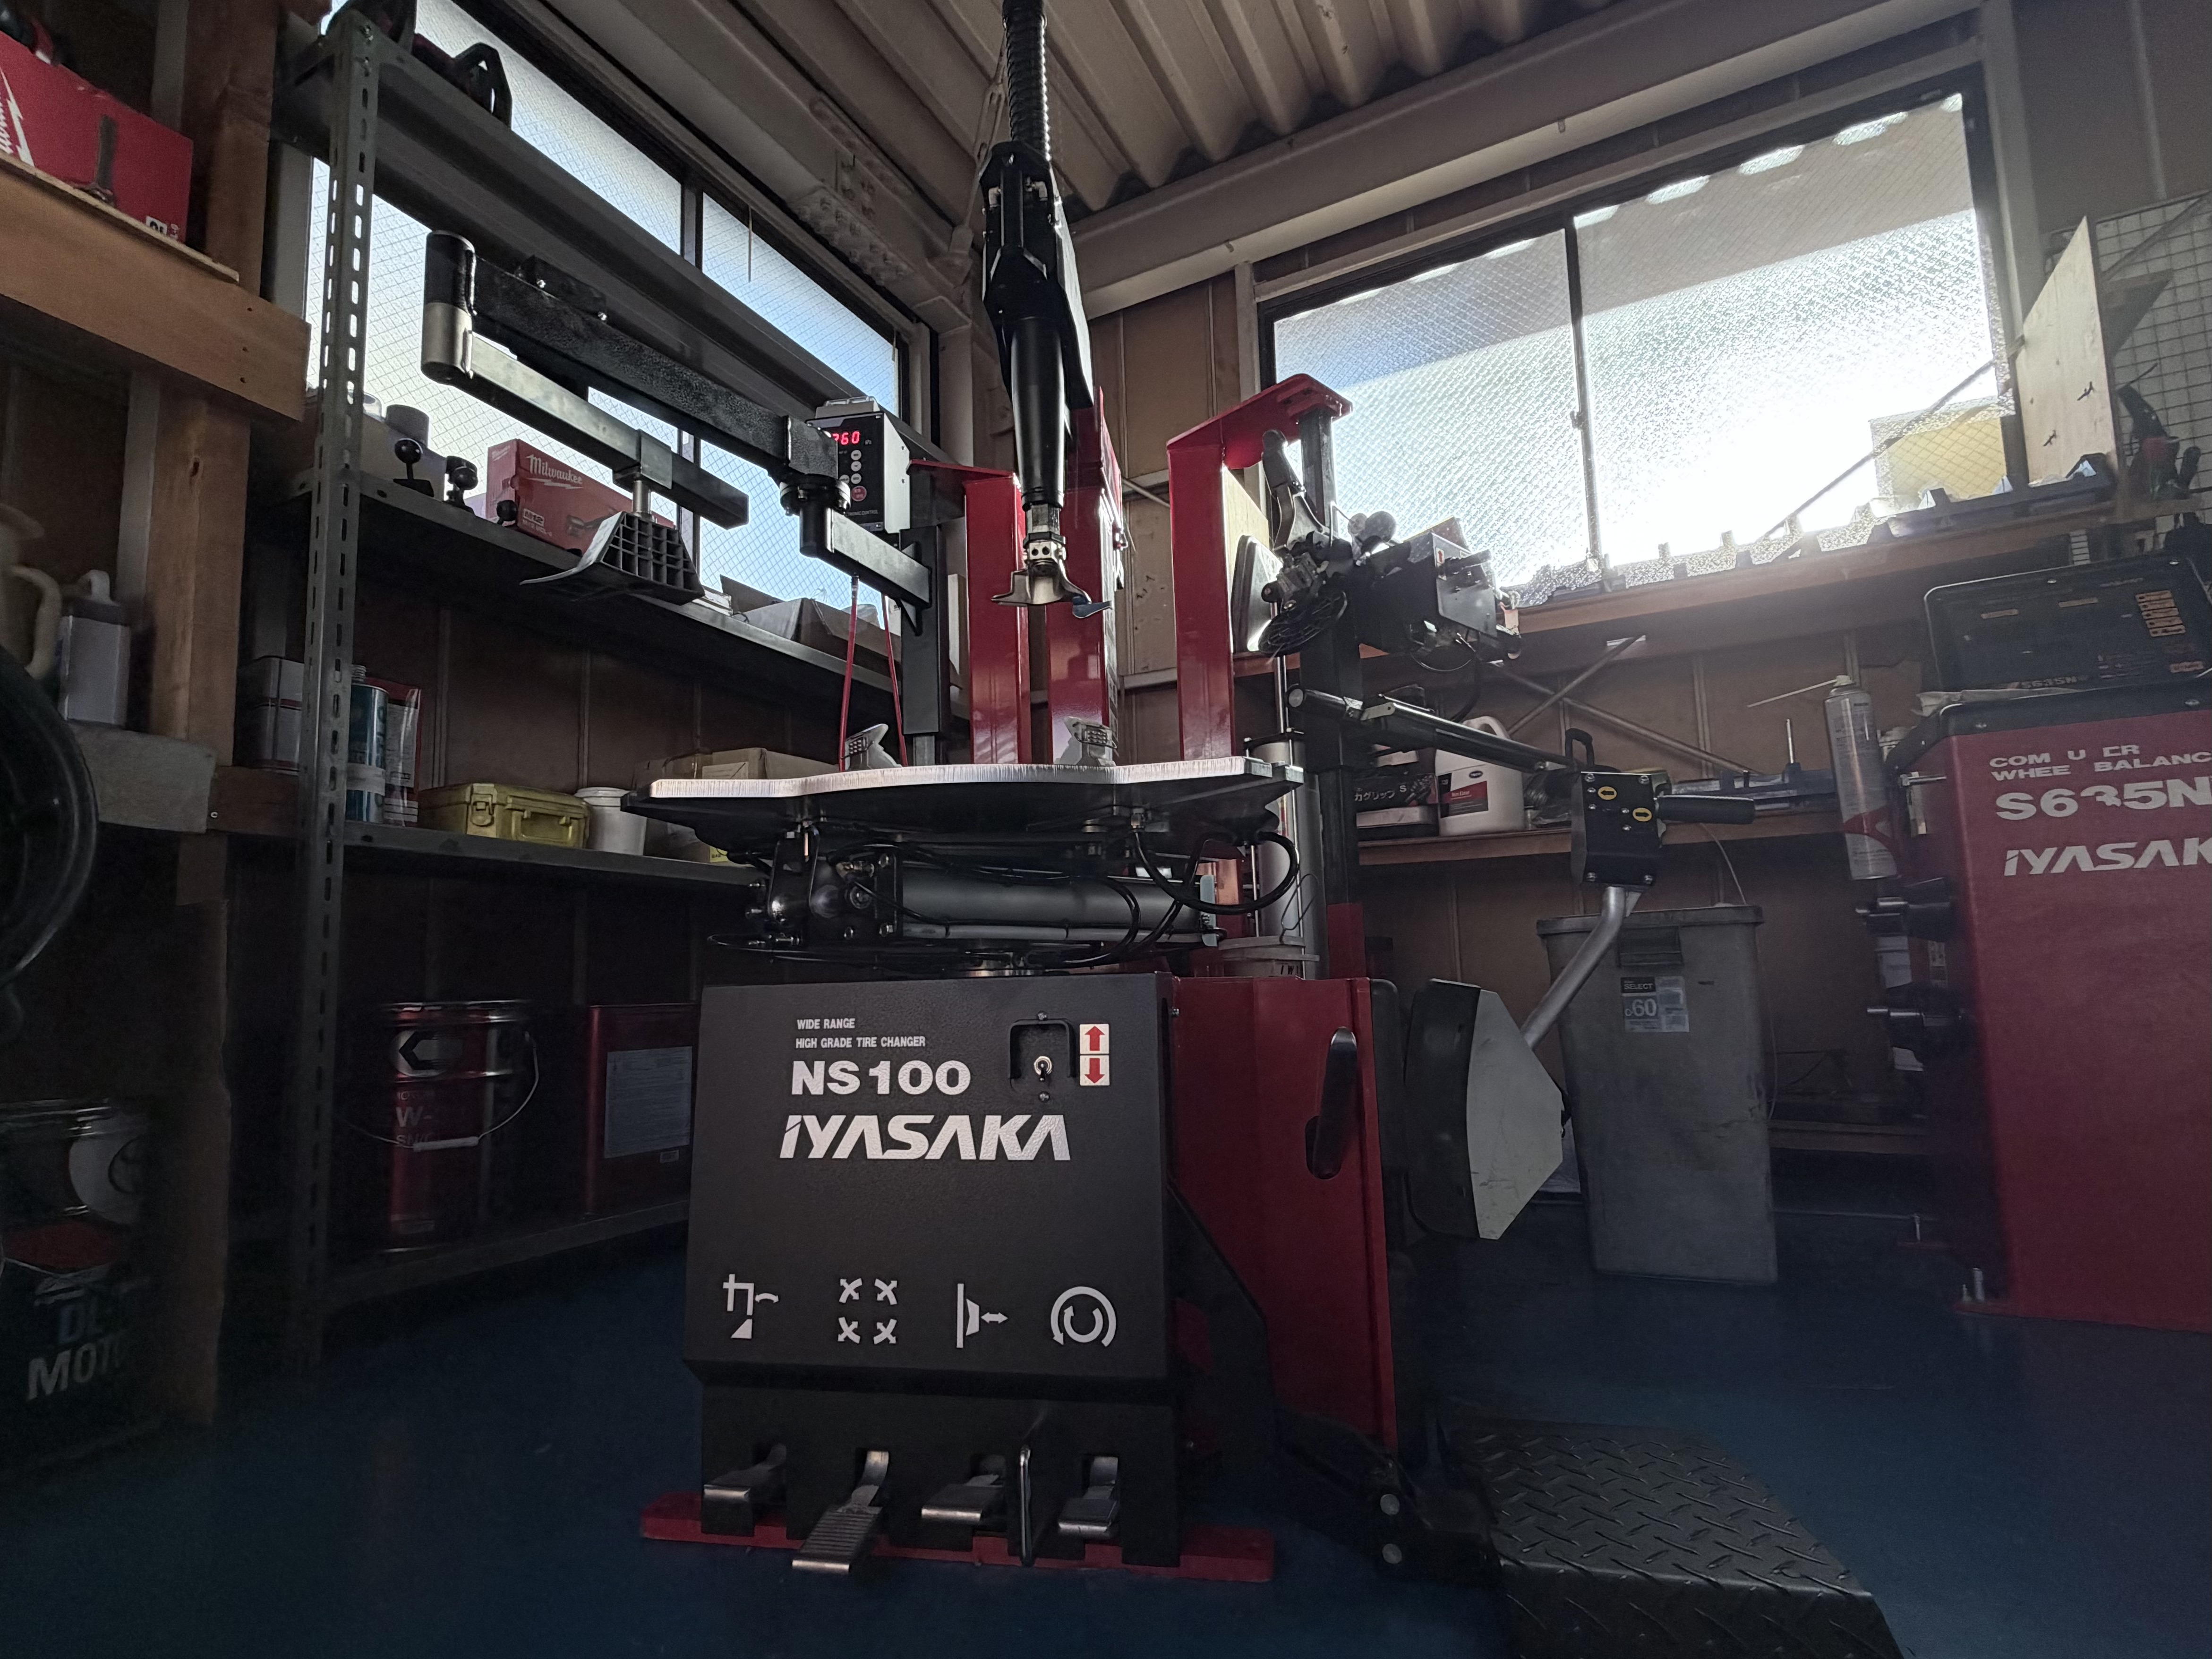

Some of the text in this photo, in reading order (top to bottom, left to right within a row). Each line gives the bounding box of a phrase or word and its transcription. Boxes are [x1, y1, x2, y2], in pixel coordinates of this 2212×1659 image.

[525, 454, 583, 484] Milwaukee
[1991, 765, 2071, 781] WHEE
[797, 1018, 855, 1030] WIDE RANGE
[795, 1036, 926, 1048] HIGH GRADE TIRE CHANGER
[779, 1115, 1071, 1161] IYASAKA
